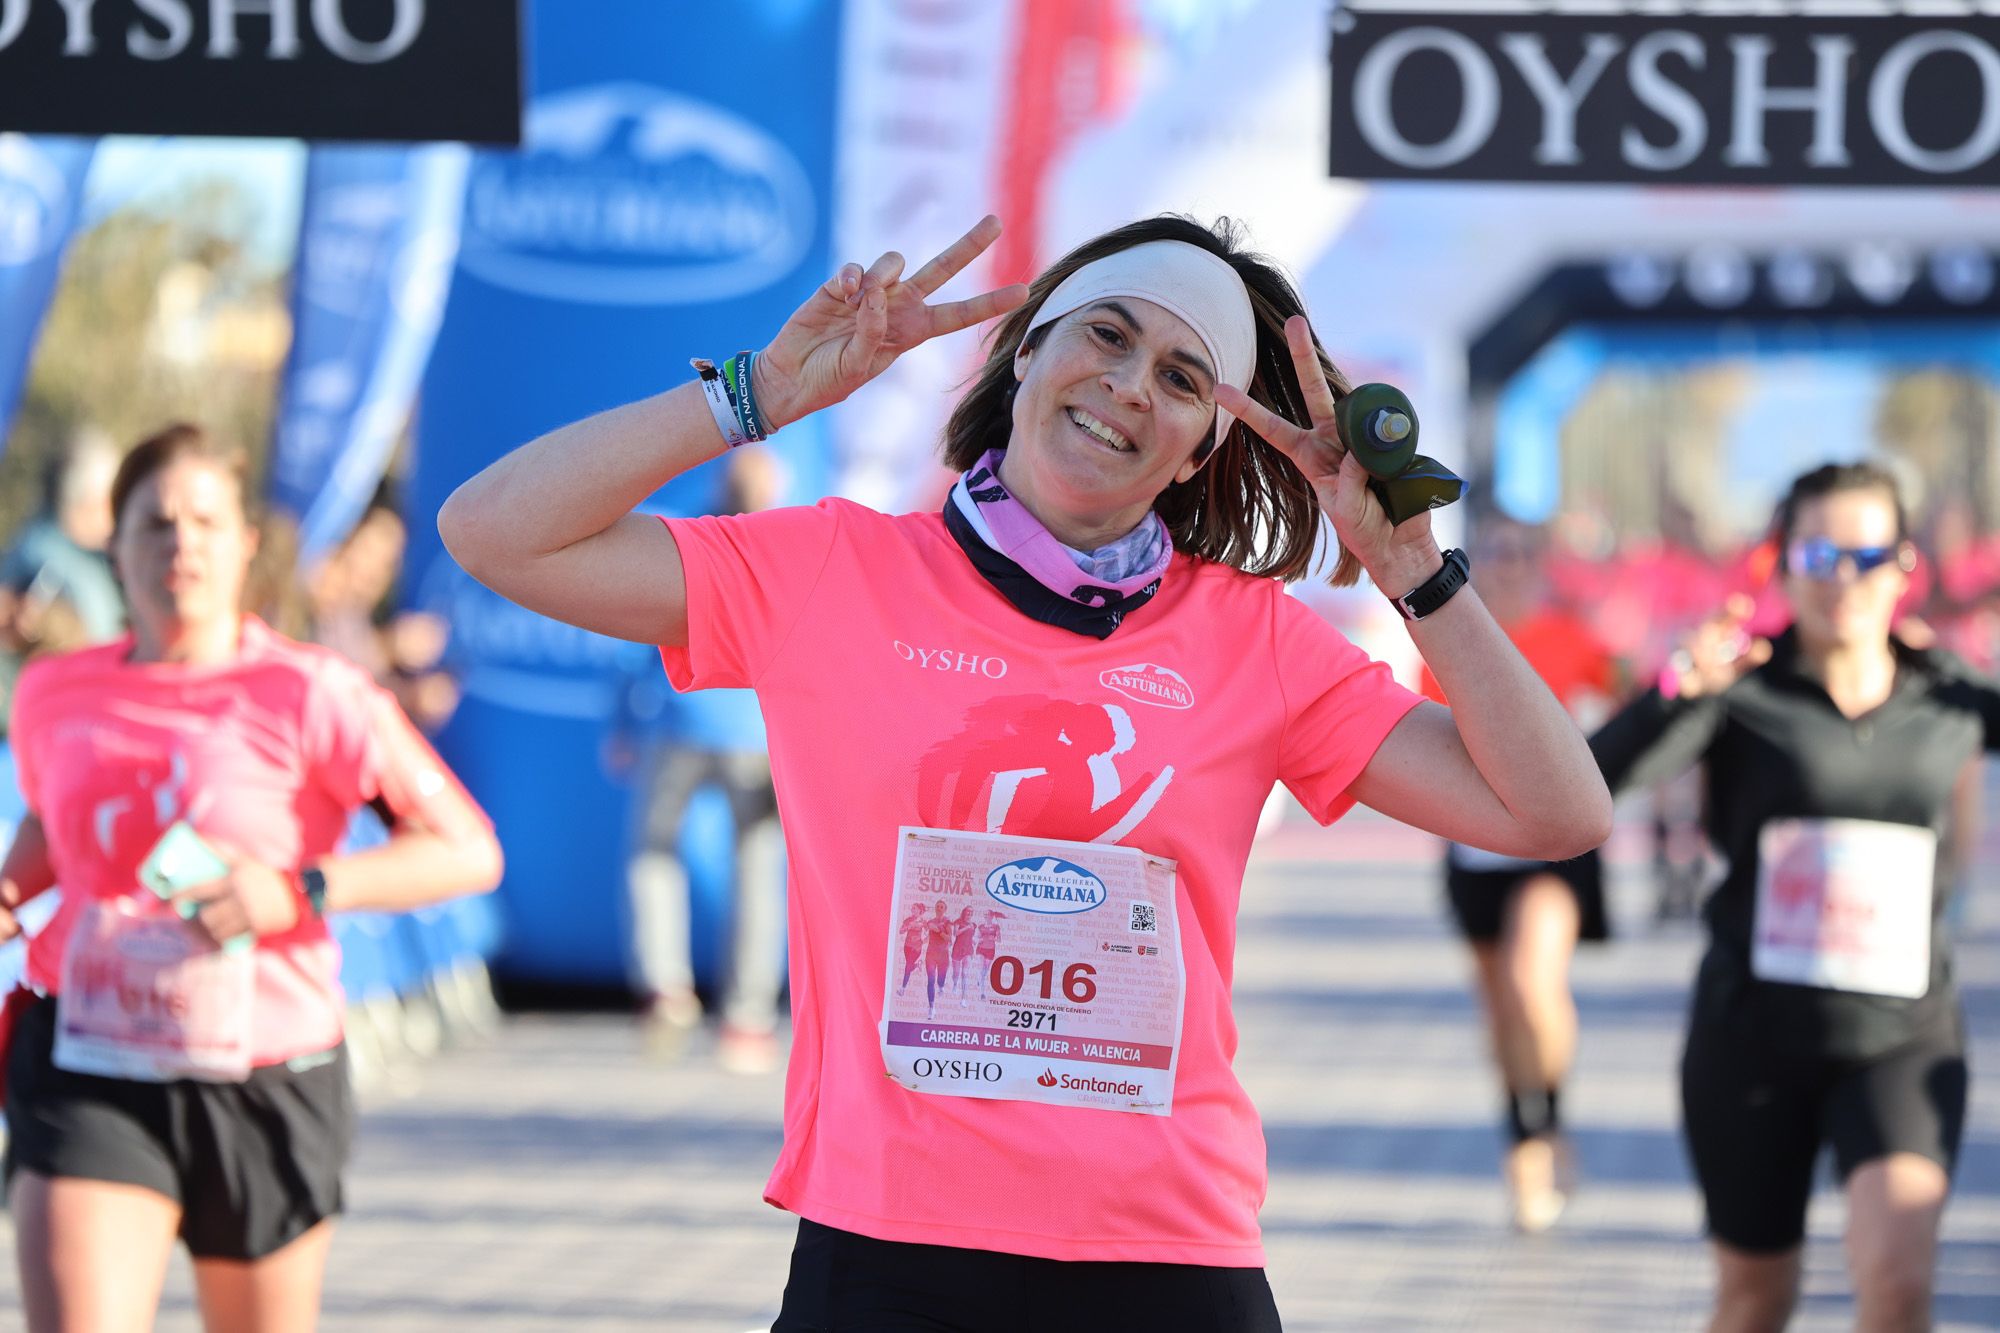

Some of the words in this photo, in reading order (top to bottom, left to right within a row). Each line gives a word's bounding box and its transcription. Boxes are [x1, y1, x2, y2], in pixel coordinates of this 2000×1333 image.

[0, 0, 425, 63] YSHO
[1351, 26, 2000, 174] OYSHO
[739, 356, 752, 414] NACIONAL
[894, 640, 1008, 679] OYSHO
[1108, 673, 1188, 705] ASTURIANA
[917, 867, 930, 878] TU
[932, 867, 974, 881] DORSAL
[917, 877, 973, 897] SUMA
[994, 873, 1097, 904] ASTURIANA
[1014, 873, 1053, 884] CENTRAL
[1054, 875, 1095, 887] LECHERA
[990, 955, 1097, 1003] 016
[989, 999, 1022, 1009] TELÉFONO
[1022, 1001, 1055, 1012] VIOLENCIA
[1066, 1006, 1091, 1015] GÉNERO
[1007, 1009, 1057, 1031] 2971
[920, 1029, 979, 1046] CARRERA
[984, 1034, 1000, 1048] DE
[1004, 1035, 1020, 1049] LA
[1025, 1037, 1069, 1054] MUJER
[1082, 1043, 1141, 1062] VALENCIA
[913, 1058, 1003, 1082] OYSHO
[1060, 1073, 1143, 1097] Santander
